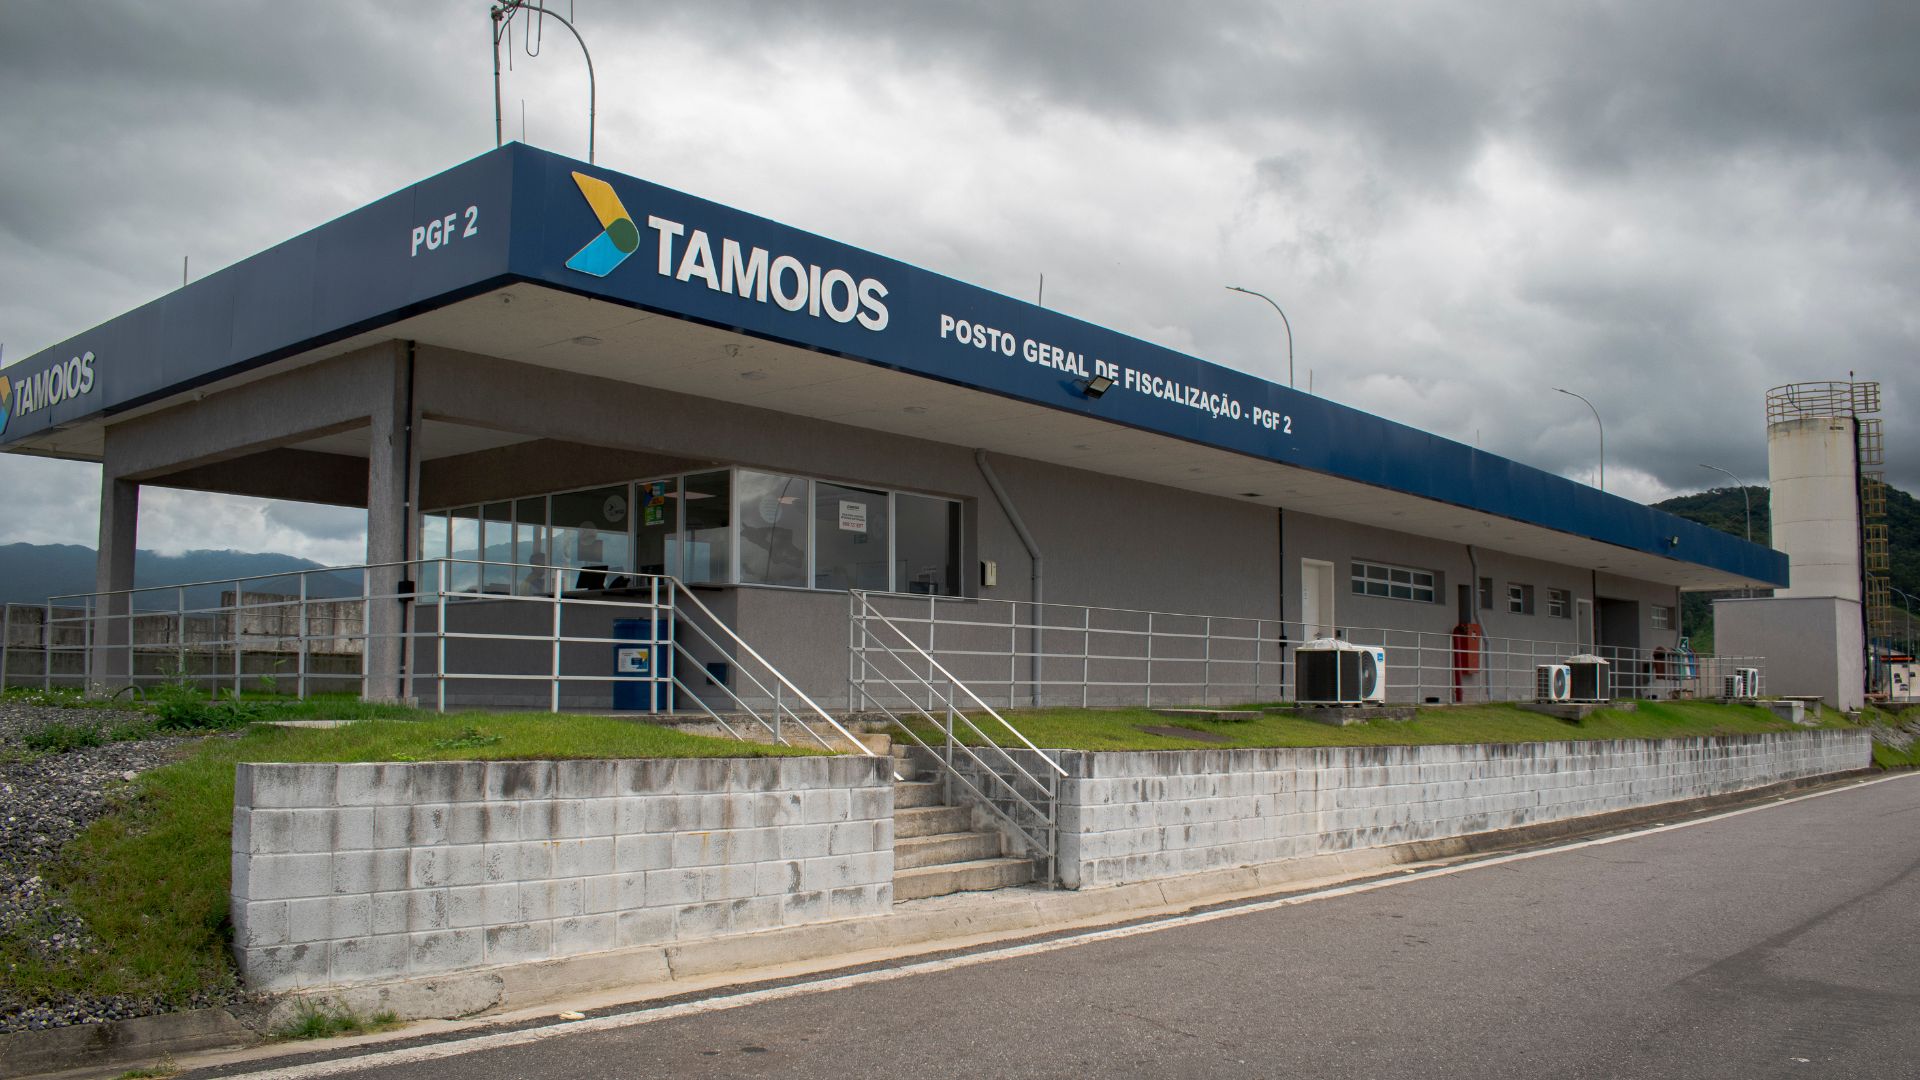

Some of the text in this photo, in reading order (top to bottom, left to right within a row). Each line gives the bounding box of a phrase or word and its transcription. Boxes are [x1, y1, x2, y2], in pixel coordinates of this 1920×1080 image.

[411, 205, 477, 257] PGF 2
[648, 214, 889, 332] TAMOIOS
[15, 351, 94, 417] TAMOIOS
[940, 313, 1016, 357] POSTO
[1023, 339, 1089, 378] GERAL
[1095, 359, 1119, 386] DE
[1125, 367, 1241, 420] FISCALIZAÇÃO
[1253, 406, 1280, 430] PGF
[1283, 415, 1292, 434] 2
